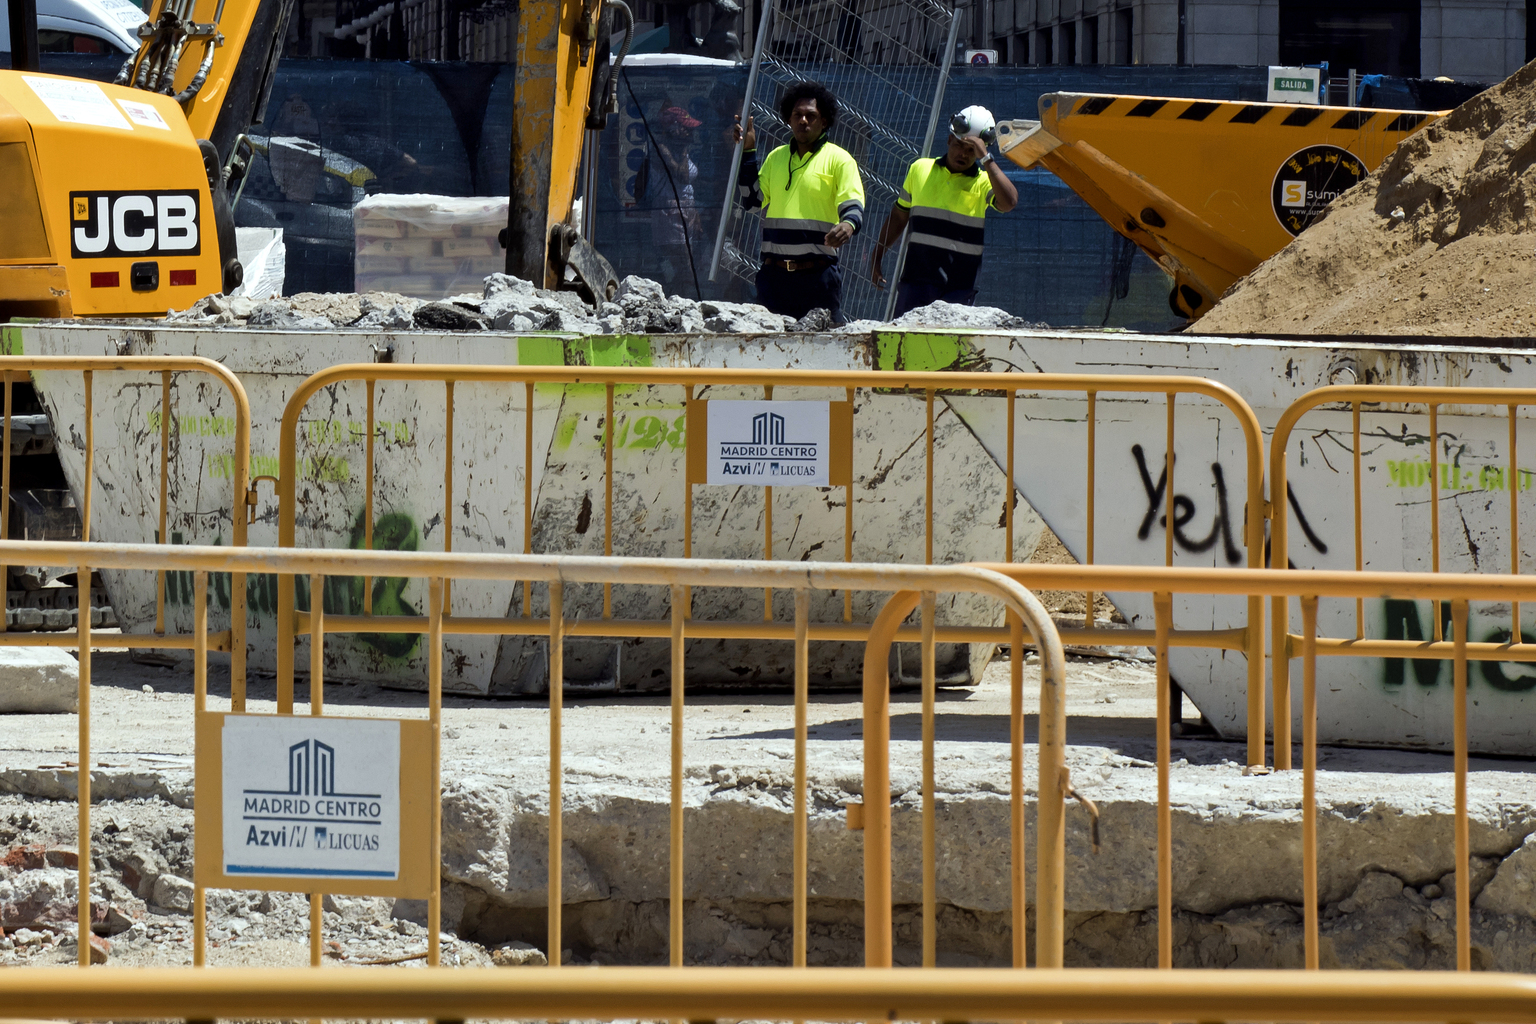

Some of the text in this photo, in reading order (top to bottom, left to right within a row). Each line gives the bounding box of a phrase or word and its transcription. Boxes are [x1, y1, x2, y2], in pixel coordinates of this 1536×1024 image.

[1280, 79, 1307, 90] SALIDA
[74, 195, 198, 253] JCB
[720, 446, 817, 457] MADRID CENTRO
[722, 461, 816, 476] Azvi LICUAS
[244, 797, 381, 817] MADRID CENTRO
[246, 825, 379, 851] Azvi LICUAS
